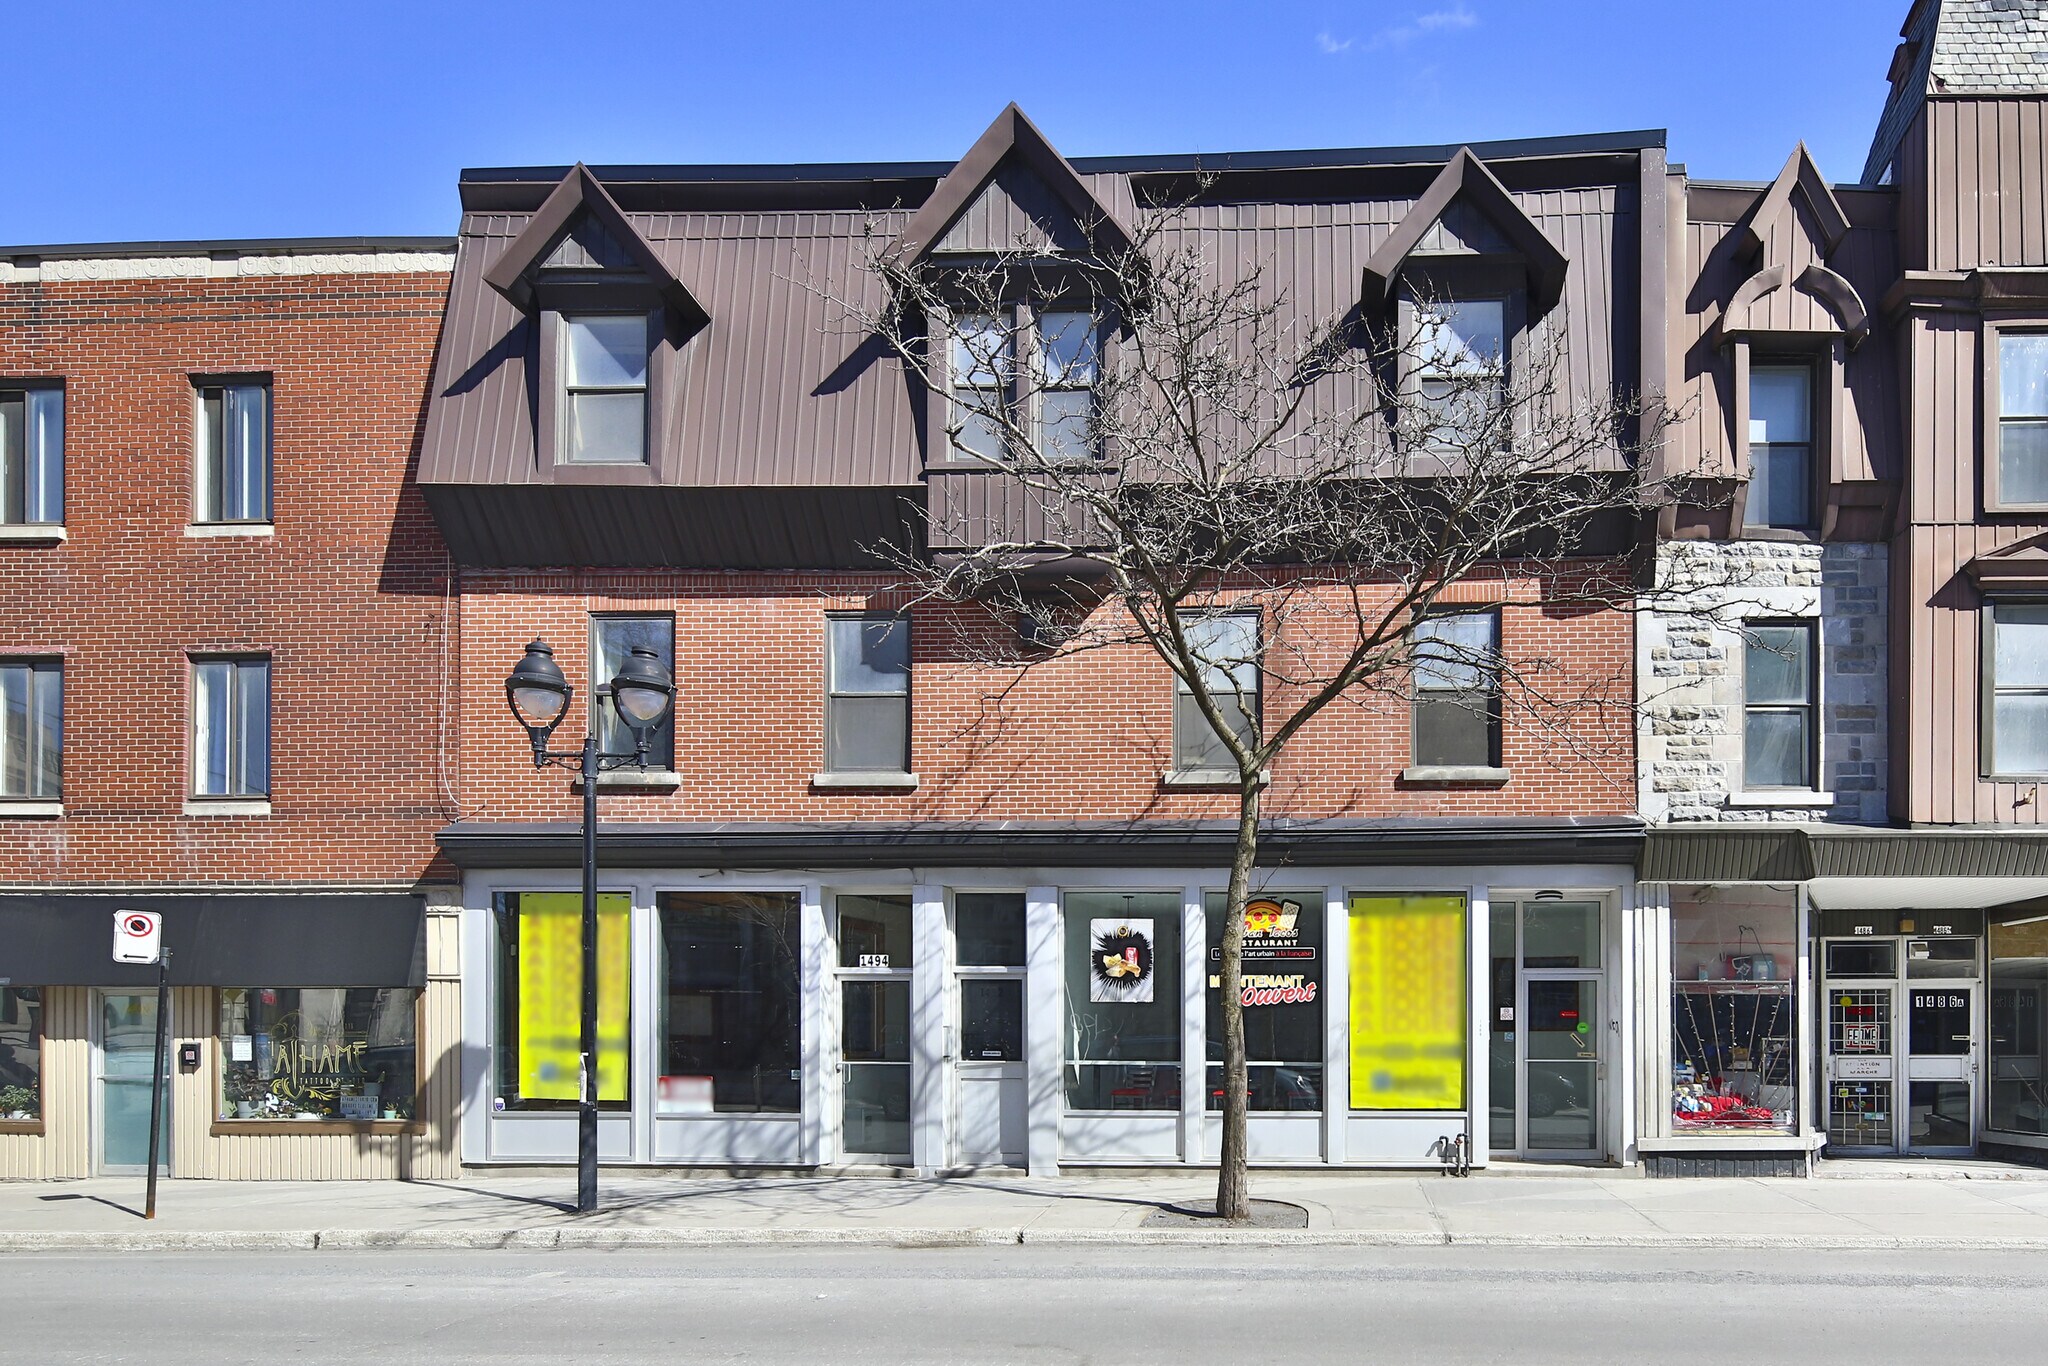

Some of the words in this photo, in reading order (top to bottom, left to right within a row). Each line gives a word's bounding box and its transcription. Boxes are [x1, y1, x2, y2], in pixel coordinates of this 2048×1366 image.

[1242, 925, 1263, 938] ban
[1268, 925, 1299, 938] Tacos
[1241, 939, 1298, 947] STAURANT
[1288, 950, 1312, 958] française
[861, 955, 889, 967] 1494
[1209, 975, 1304, 989] MNTENANT
[1241, 982, 1317, 1006] Ouvert
[299, 1077, 330, 1085] TATTOO
[333, 1077, 365, 1085] STDIO
